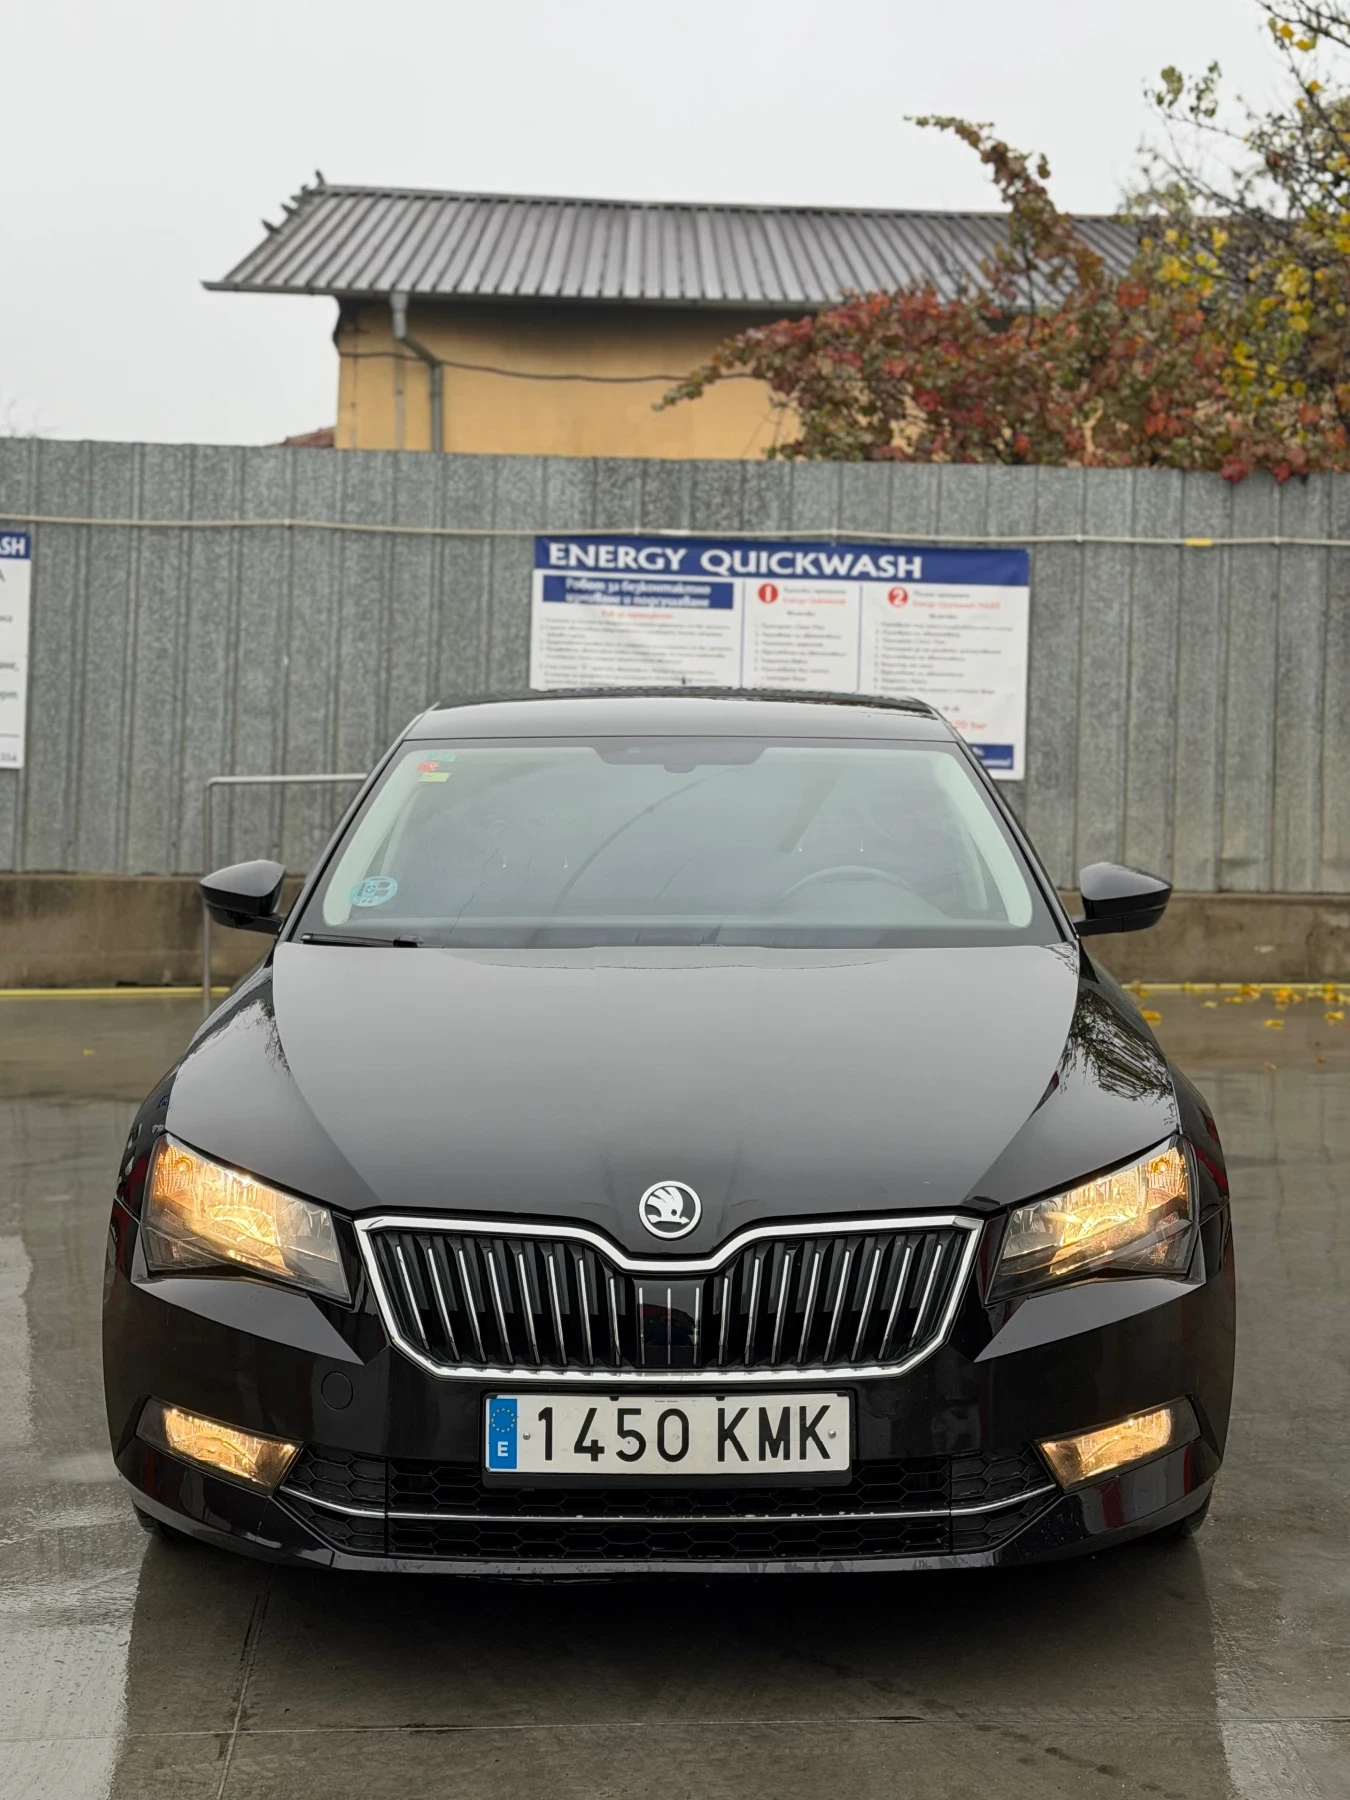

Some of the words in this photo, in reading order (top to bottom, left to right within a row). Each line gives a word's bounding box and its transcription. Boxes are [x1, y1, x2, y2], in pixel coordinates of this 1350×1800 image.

[0, 536, 26, 557] SH
[548, 542, 687, 571] ENERGY
[700, 548, 923, 579] QUICKWASH
[892, 588, 905, 607] 2
[538, 1406, 689, 1463] 1450
[717, 1405, 832, 1462] KMK
[497, 1441, 508, 1457] E
